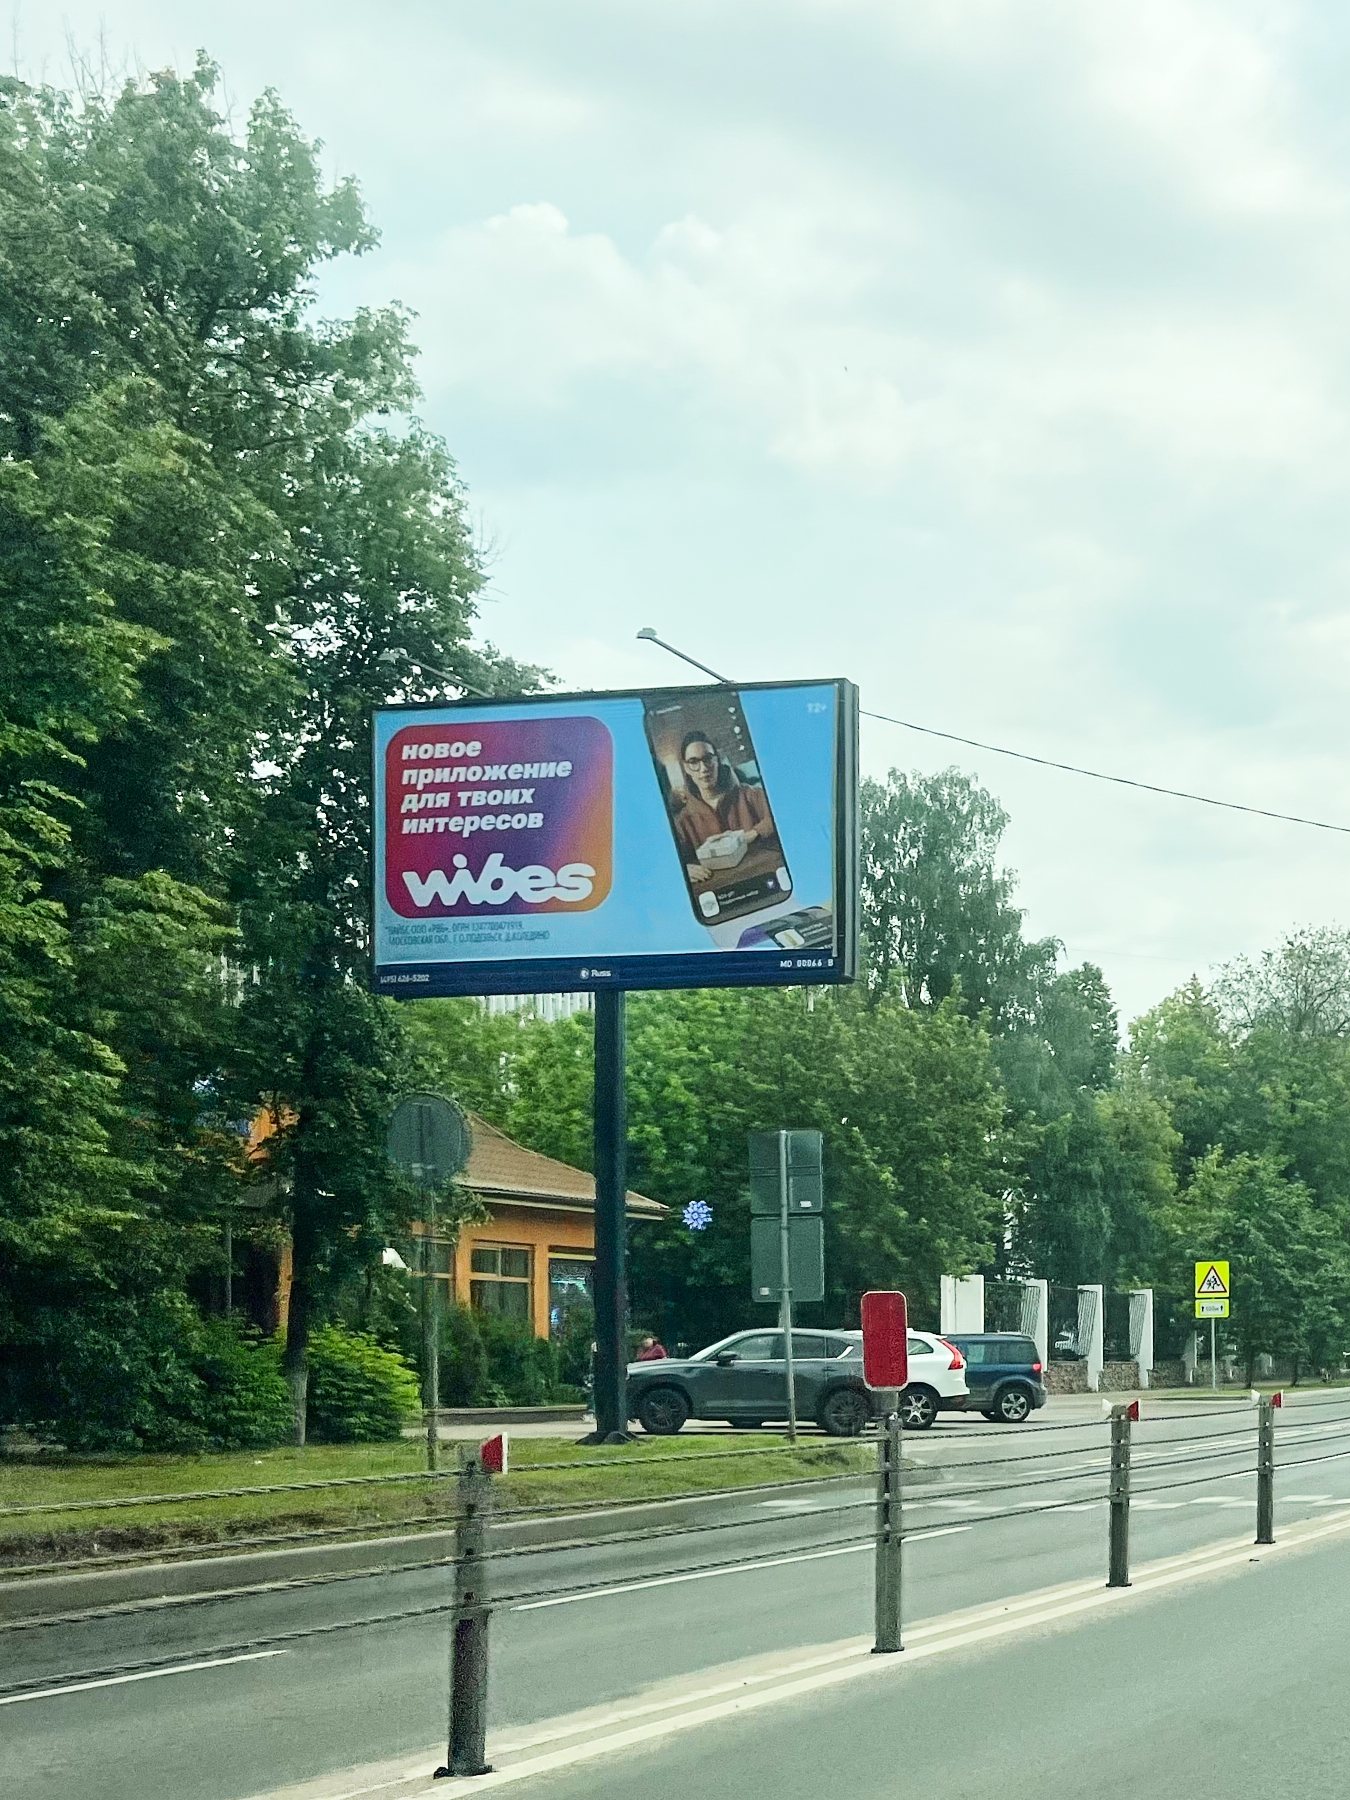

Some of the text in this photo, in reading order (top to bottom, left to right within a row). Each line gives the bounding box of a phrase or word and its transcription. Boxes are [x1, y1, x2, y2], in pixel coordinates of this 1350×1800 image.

[401, 741, 482, 760] новое
[401, 761, 573, 790] приложение
[400, 788, 536, 813] для твоих
[401, 812, 544, 838] интересов
[402, 852, 597, 907] wibes
